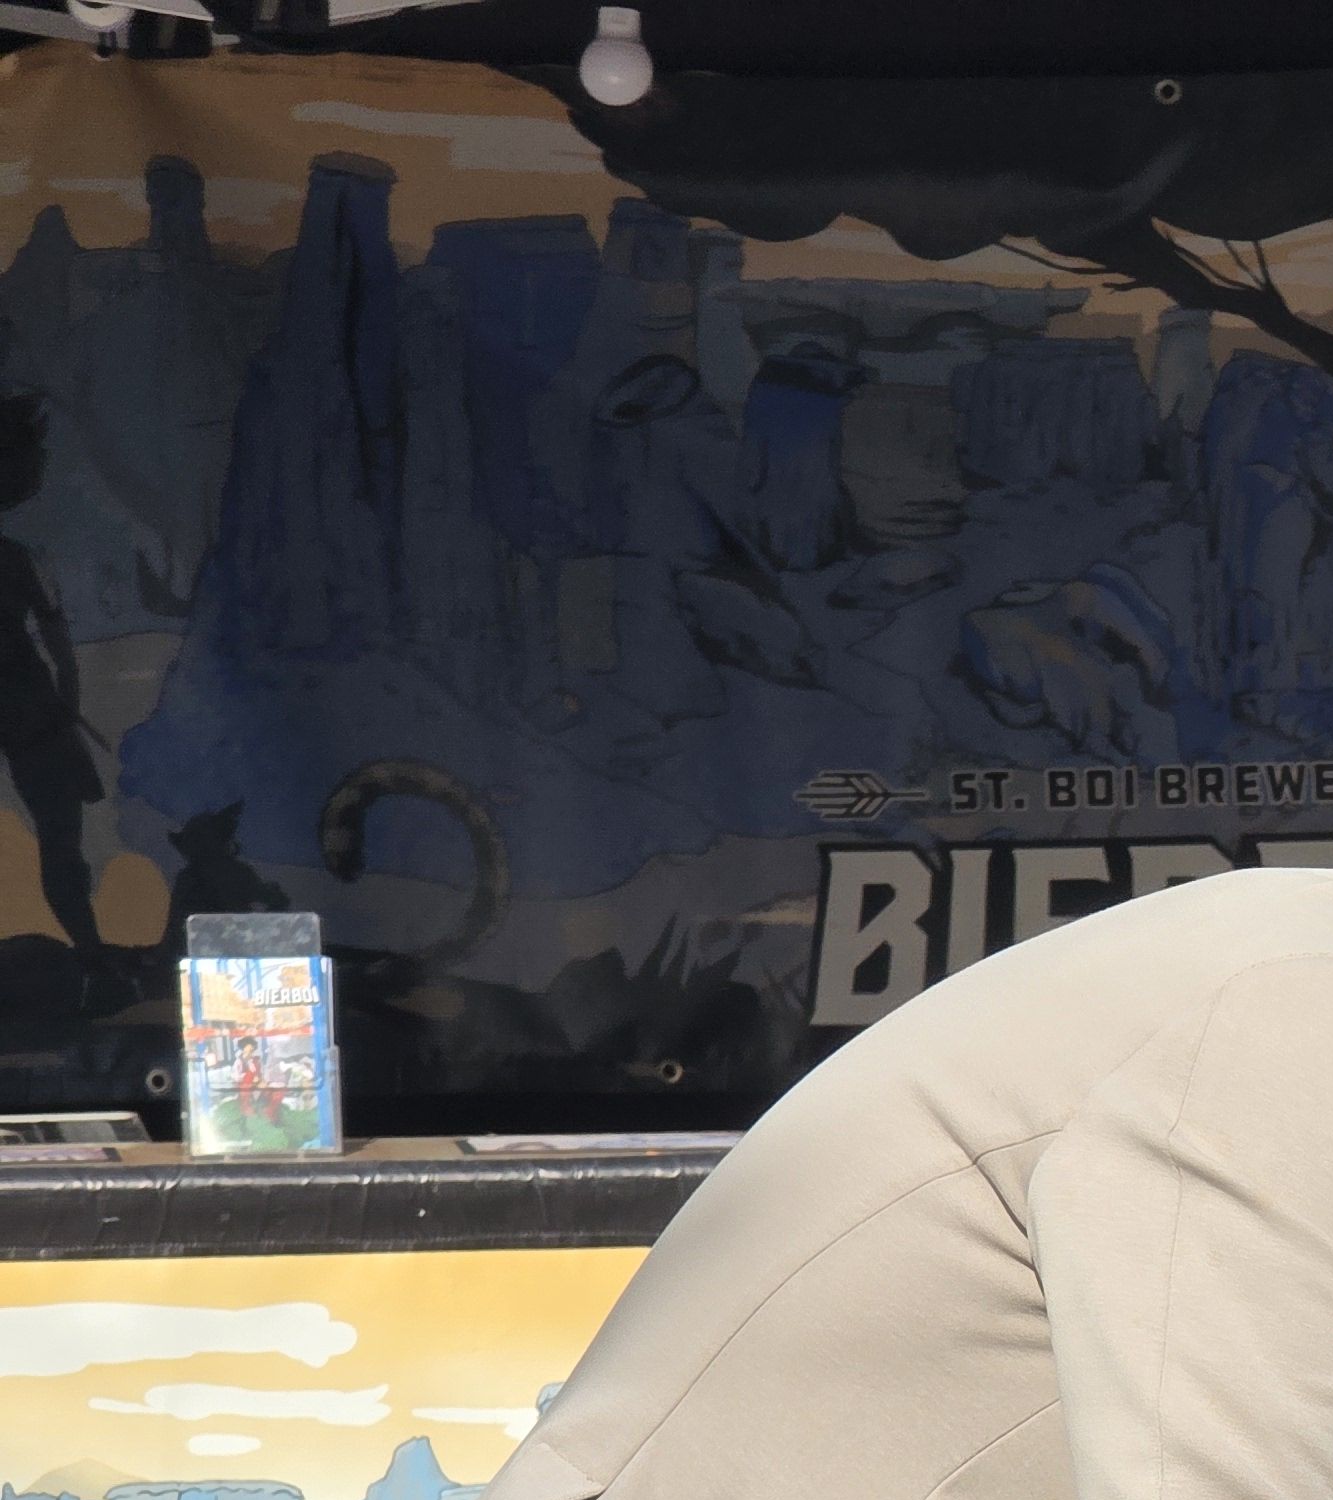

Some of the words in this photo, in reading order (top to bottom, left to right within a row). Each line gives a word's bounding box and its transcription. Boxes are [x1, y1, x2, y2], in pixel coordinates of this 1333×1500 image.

[951, 772, 1025, 811] ST.
[1047, 767, 1137, 809] BOI
[255, 986, 320, 1008] BIERBOI
